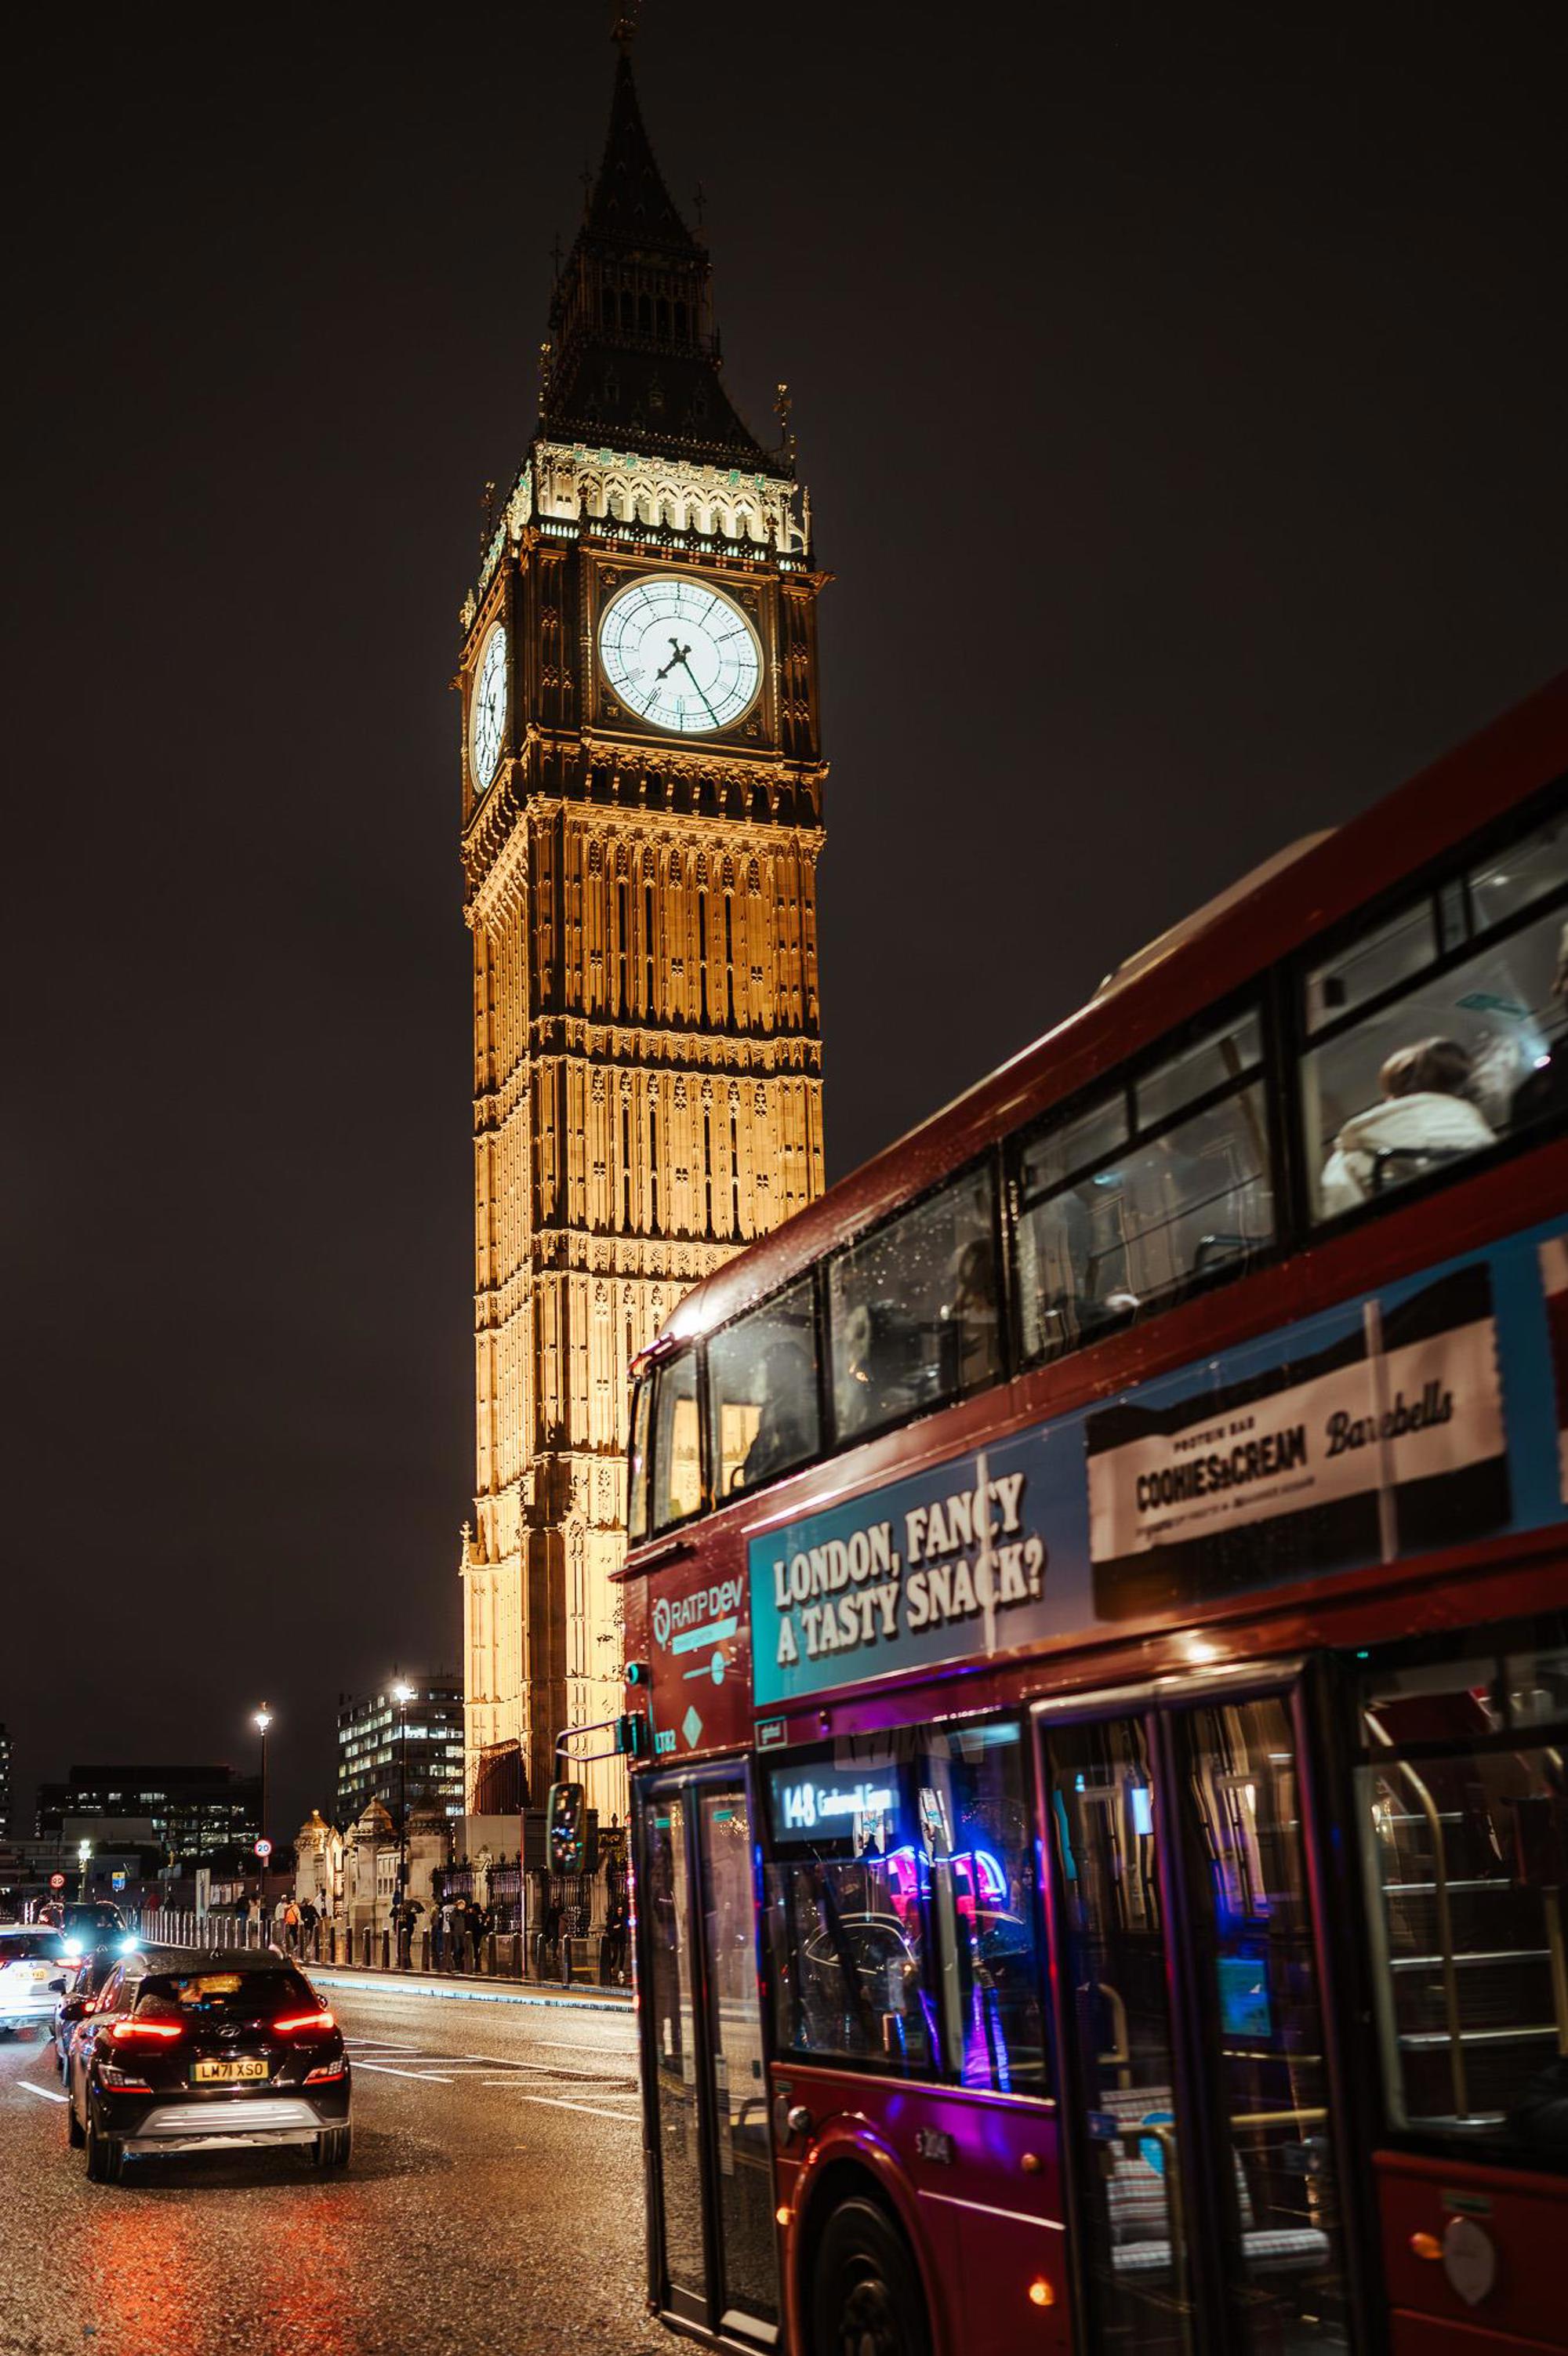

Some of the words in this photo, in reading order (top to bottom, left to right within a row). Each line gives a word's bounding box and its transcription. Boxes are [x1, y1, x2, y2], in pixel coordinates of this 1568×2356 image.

[773, 1521, 901, 1608] LONDON,
[905, 1472, 1025, 1564] FANCY
[776, 1617, 798, 1664] A
[801, 1581, 901, 1657] TASTY
[906, 1537, 1044, 1629] SNACK?
[783, 1782, 816, 1829] 148
